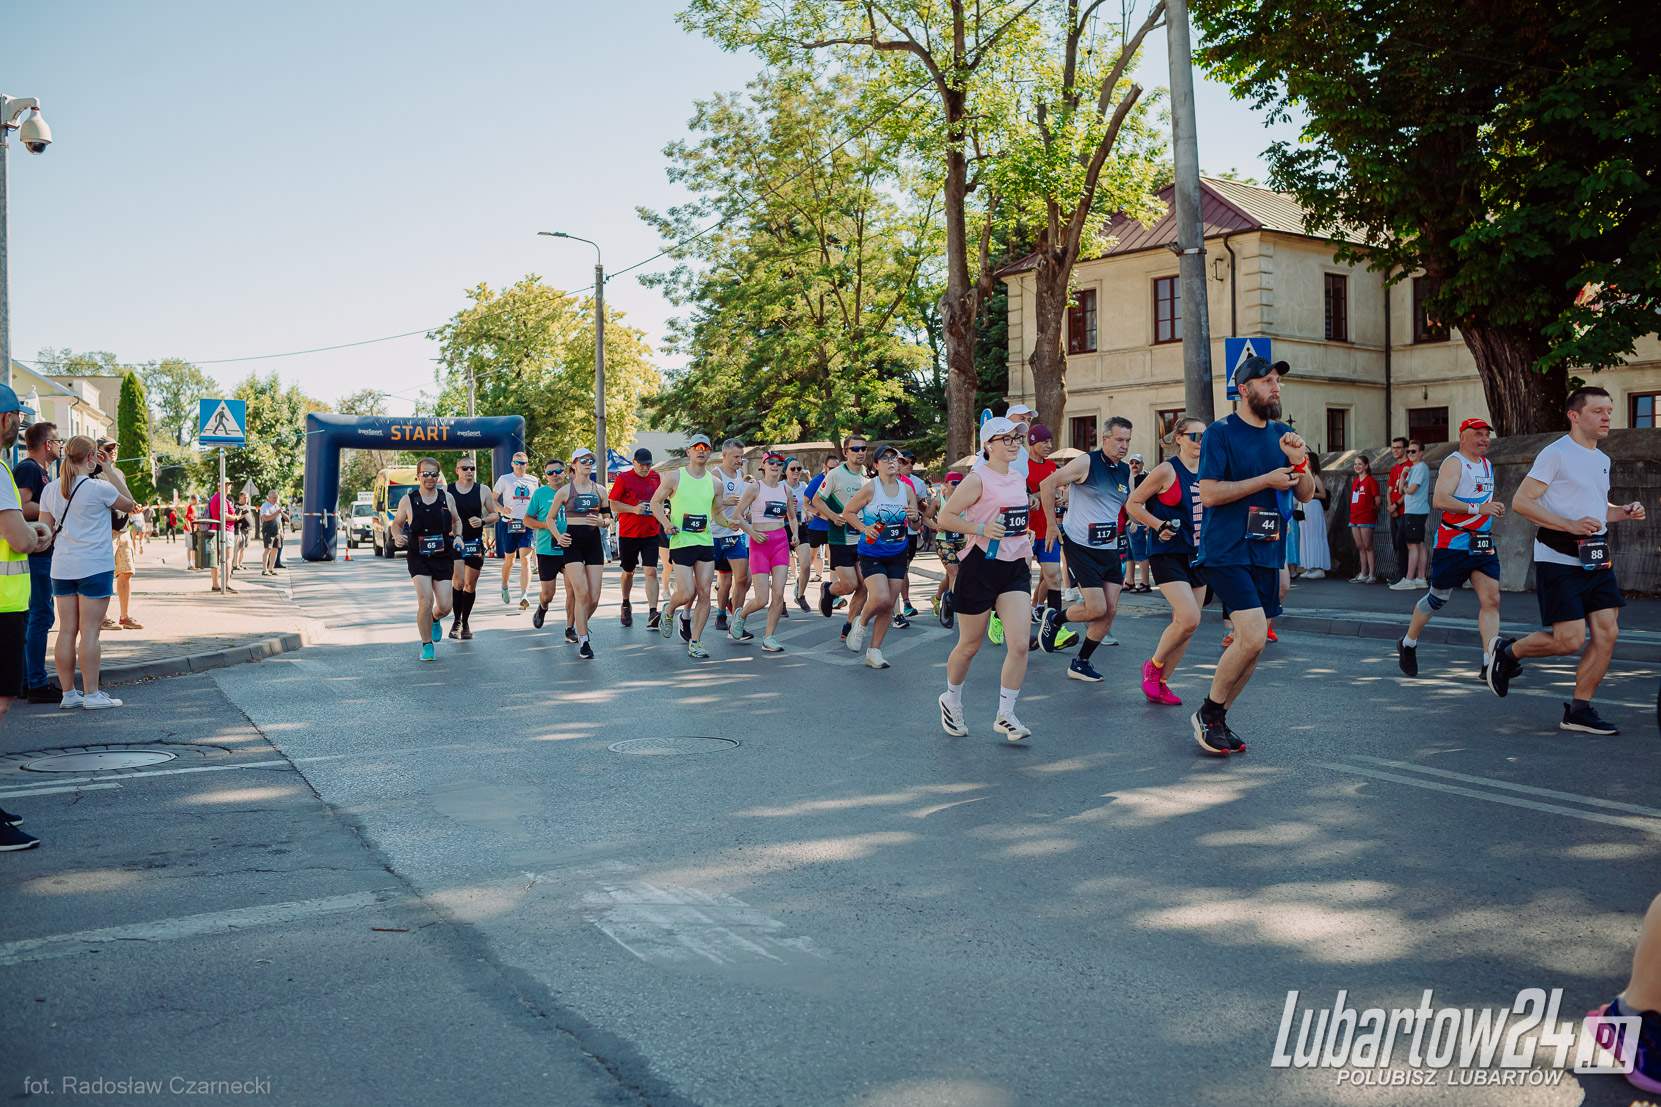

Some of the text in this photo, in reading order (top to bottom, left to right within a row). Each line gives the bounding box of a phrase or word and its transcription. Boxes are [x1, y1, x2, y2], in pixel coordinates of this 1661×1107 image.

[391, 425, 450, 441] START
[690, 520, 700, 528] 45
[1009, 516, 1026, 527] 106
[1262, 520, 1275, 530] 44
[890, 529, 900, 537] 39
[1096, 530, 1111, 538] 117
[1591, 549, 1603, 559] 88
